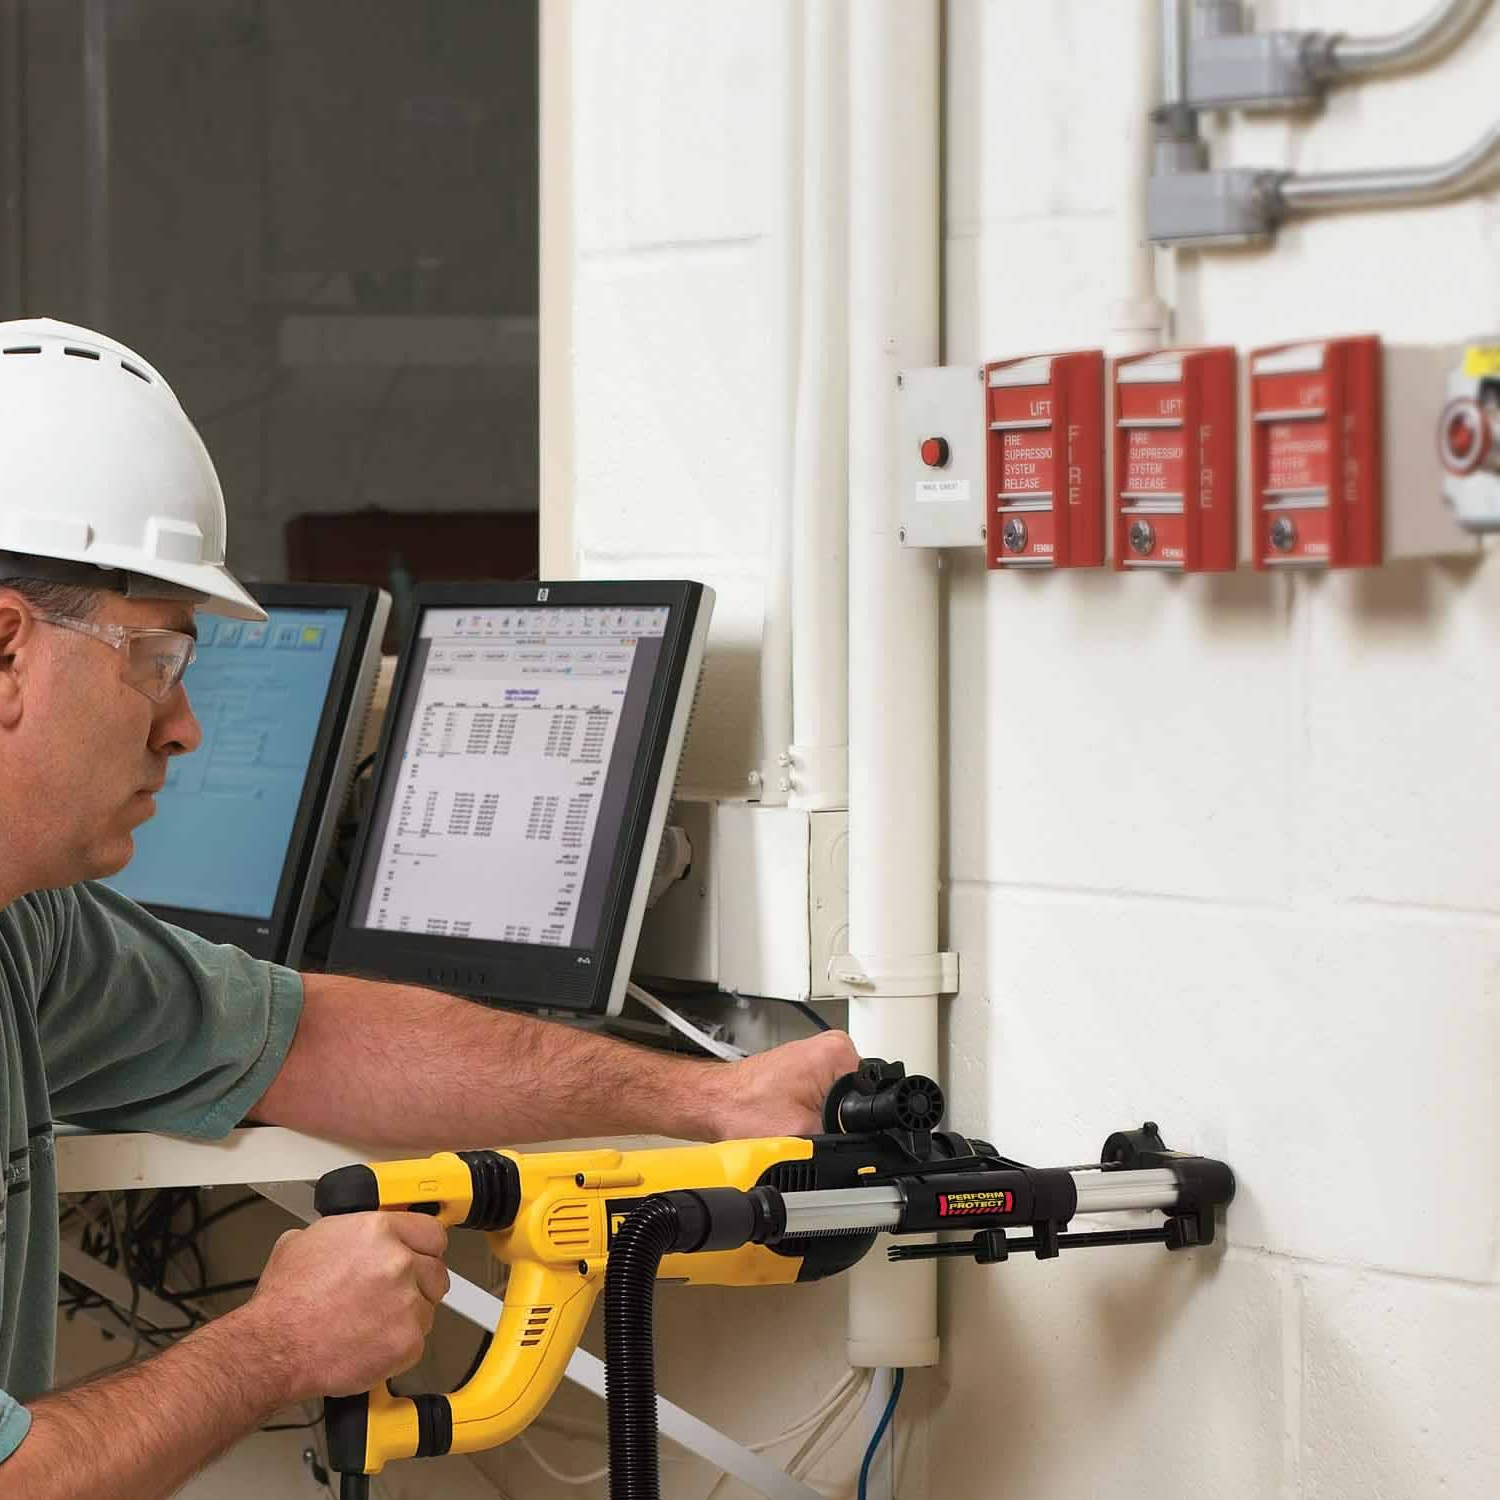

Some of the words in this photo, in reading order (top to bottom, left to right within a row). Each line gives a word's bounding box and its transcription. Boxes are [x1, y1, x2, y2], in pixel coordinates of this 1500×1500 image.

[1030, 401, 1052, 416] LIFT
[1004, 463, 1036, 475] SYSTEM
[1004, 478, 1040, 489] RELEASE
[948, 1192, 1004, 1201] PERFORM
[949, 1200, 1004, 1210] PROTECT
